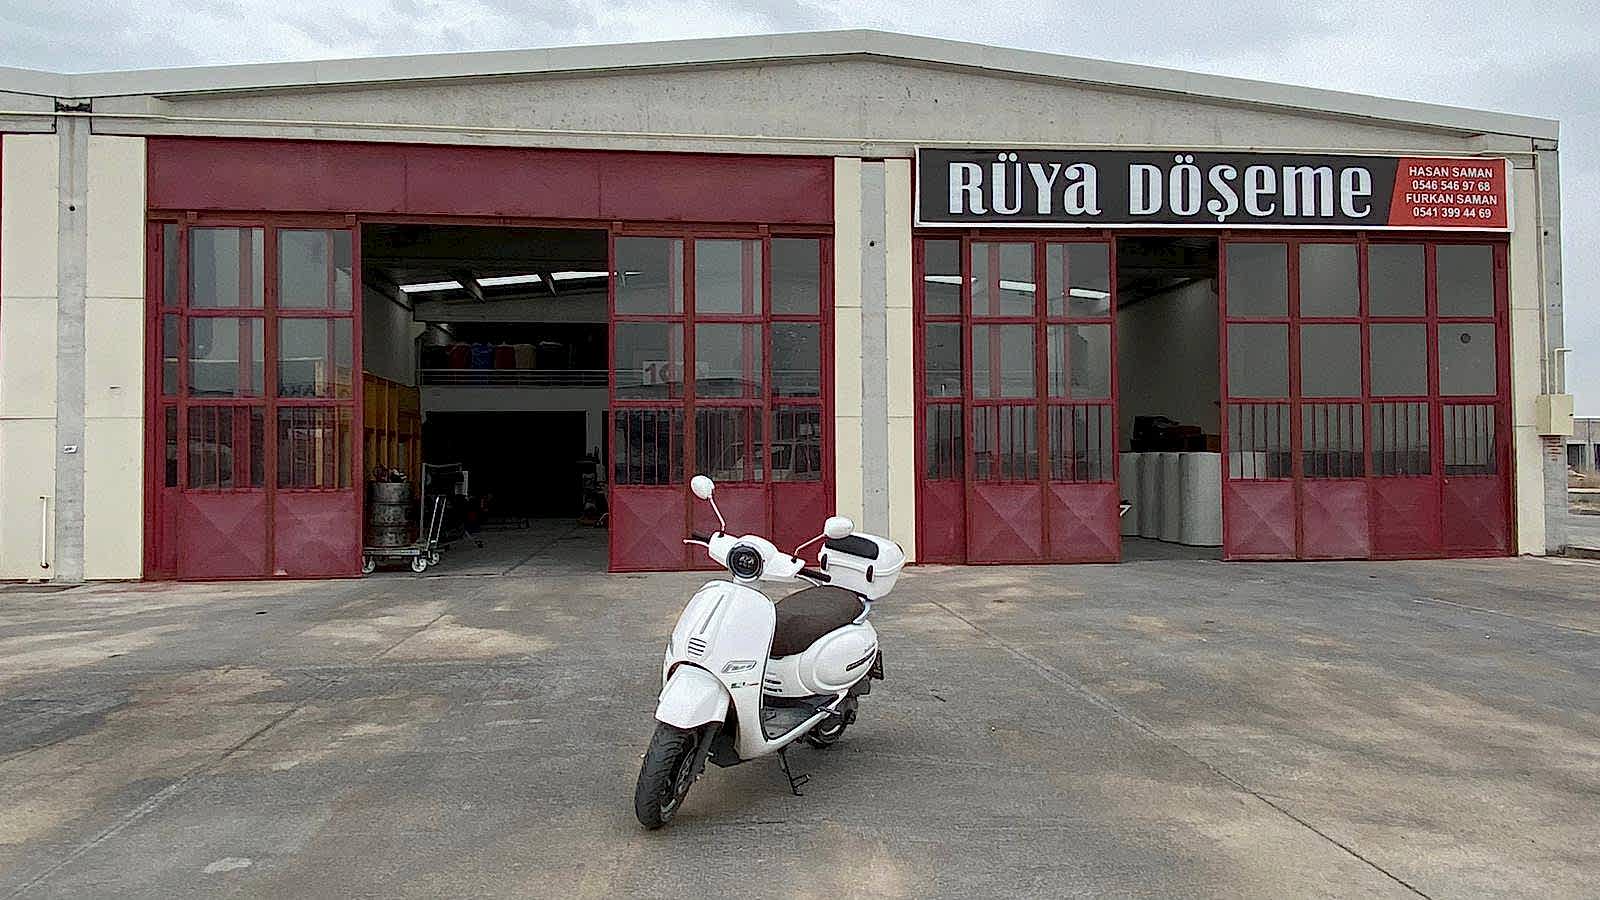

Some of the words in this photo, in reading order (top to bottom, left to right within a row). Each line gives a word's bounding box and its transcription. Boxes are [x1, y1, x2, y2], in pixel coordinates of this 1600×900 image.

[1409, 166, 1449, 177] HASAN
[1452, 167, 1493, 178] SAMAN
[1412, 180, 1438, 190] 0546
[1440, 180, 1460, 190] 546
[1462, 181, 1475, 191] 97
[1478, 181, 1491, 191] 68
[1405, 193, 1454, 204] FURKAN
[1456, 194, 1497, 205] SAMAN
[1413, 207, 1438, 217] 0541
[1441, 207, 1461, 218] 399
[1463, 208, 1476, 218] 44
[1479, 208, 1492, 219] 69
